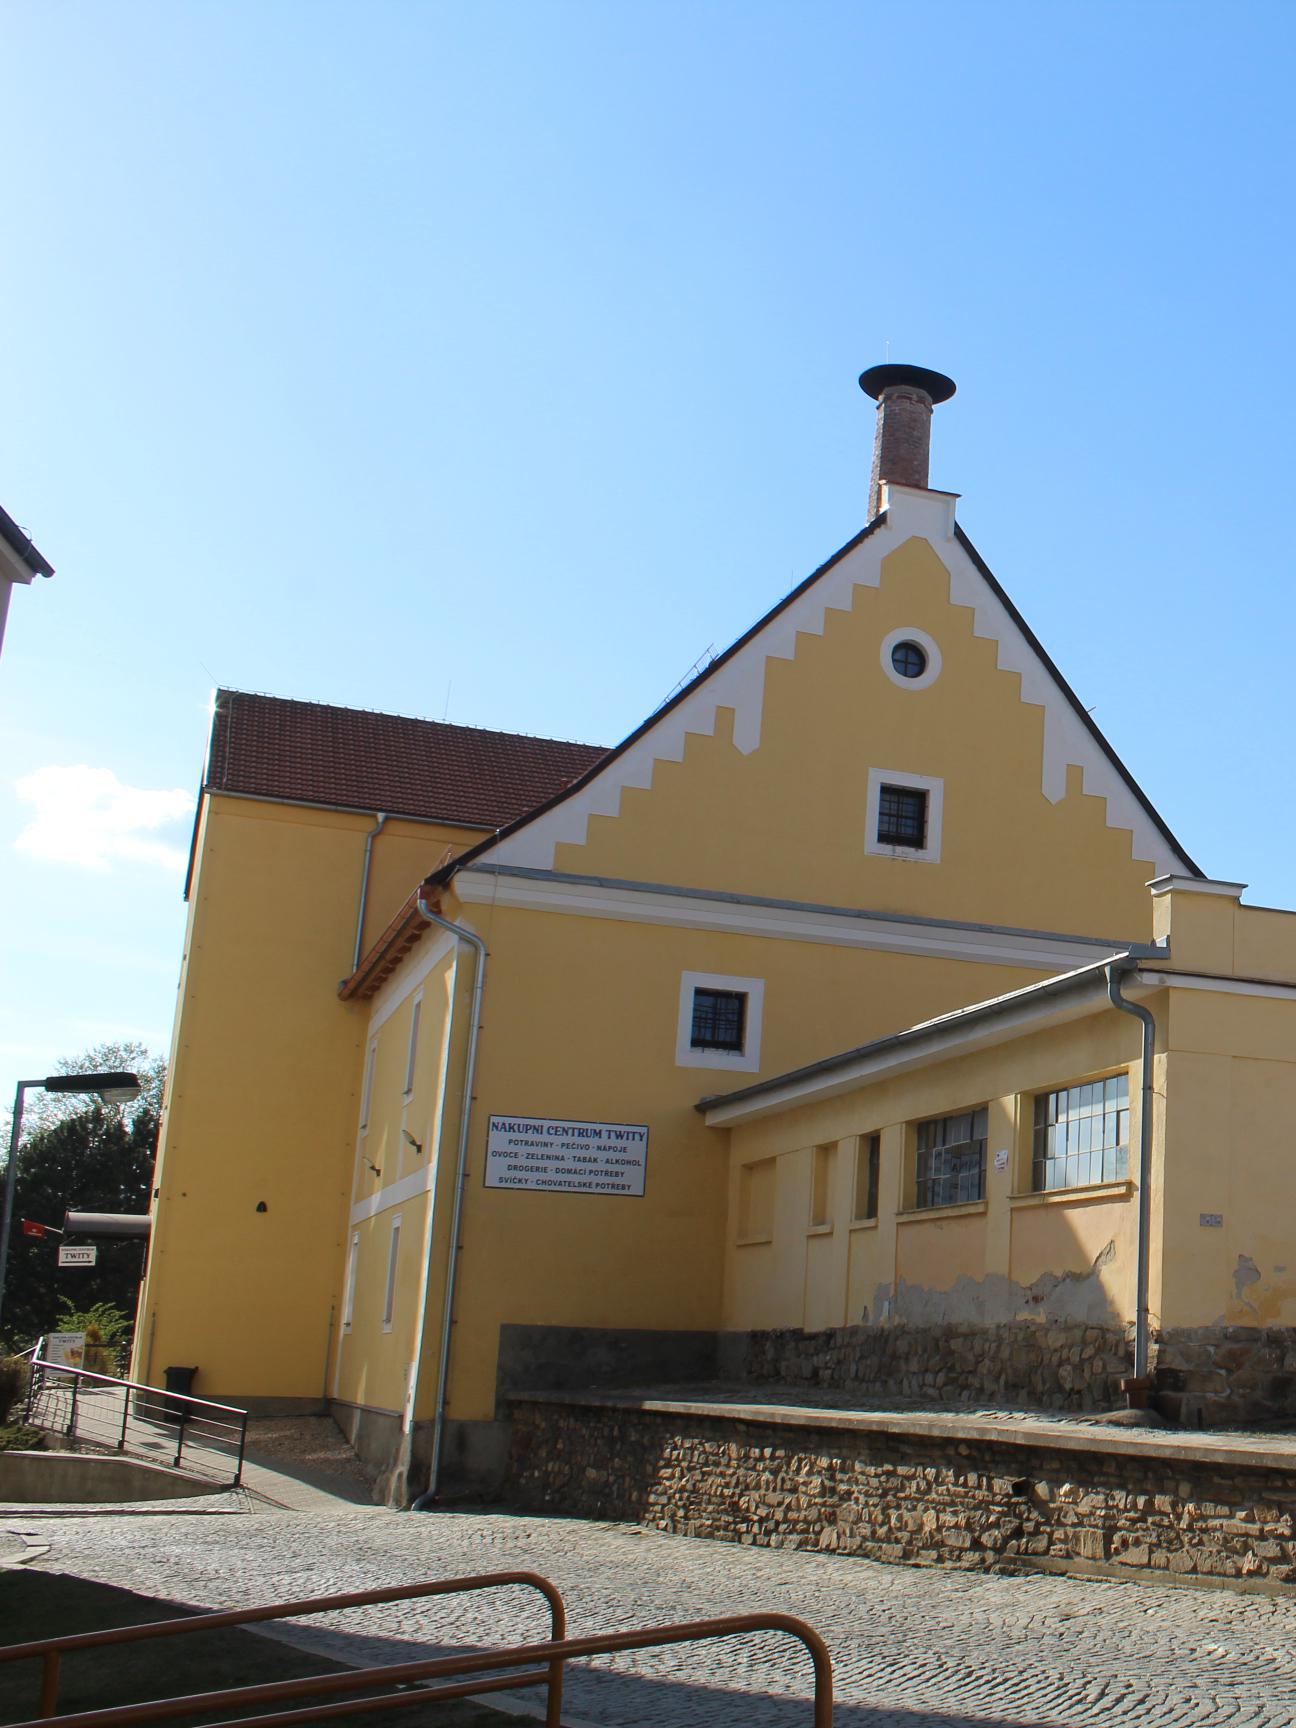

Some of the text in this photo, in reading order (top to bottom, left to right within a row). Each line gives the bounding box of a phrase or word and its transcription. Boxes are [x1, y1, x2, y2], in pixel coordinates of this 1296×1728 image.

[547, 1125, 603, 1139] CENTRUM
[604, 1129, 646, 1142] TWITY
[507, 1138, 554, 1148] POTRAVINY
[560, 1141, 591, 1151] PEČIVO
[596, 1143, 629, 1153] NÁPOJE
[491, 1150, 520, 1159] OVOCE
[525, 1152, 566, 1162] ZELENINA
[604, 1157, 642, 1167] ALKOHOL
[506, 1164, 549, 1174] DROGERIE
[64, 1252, 91, 1260] TWITY
